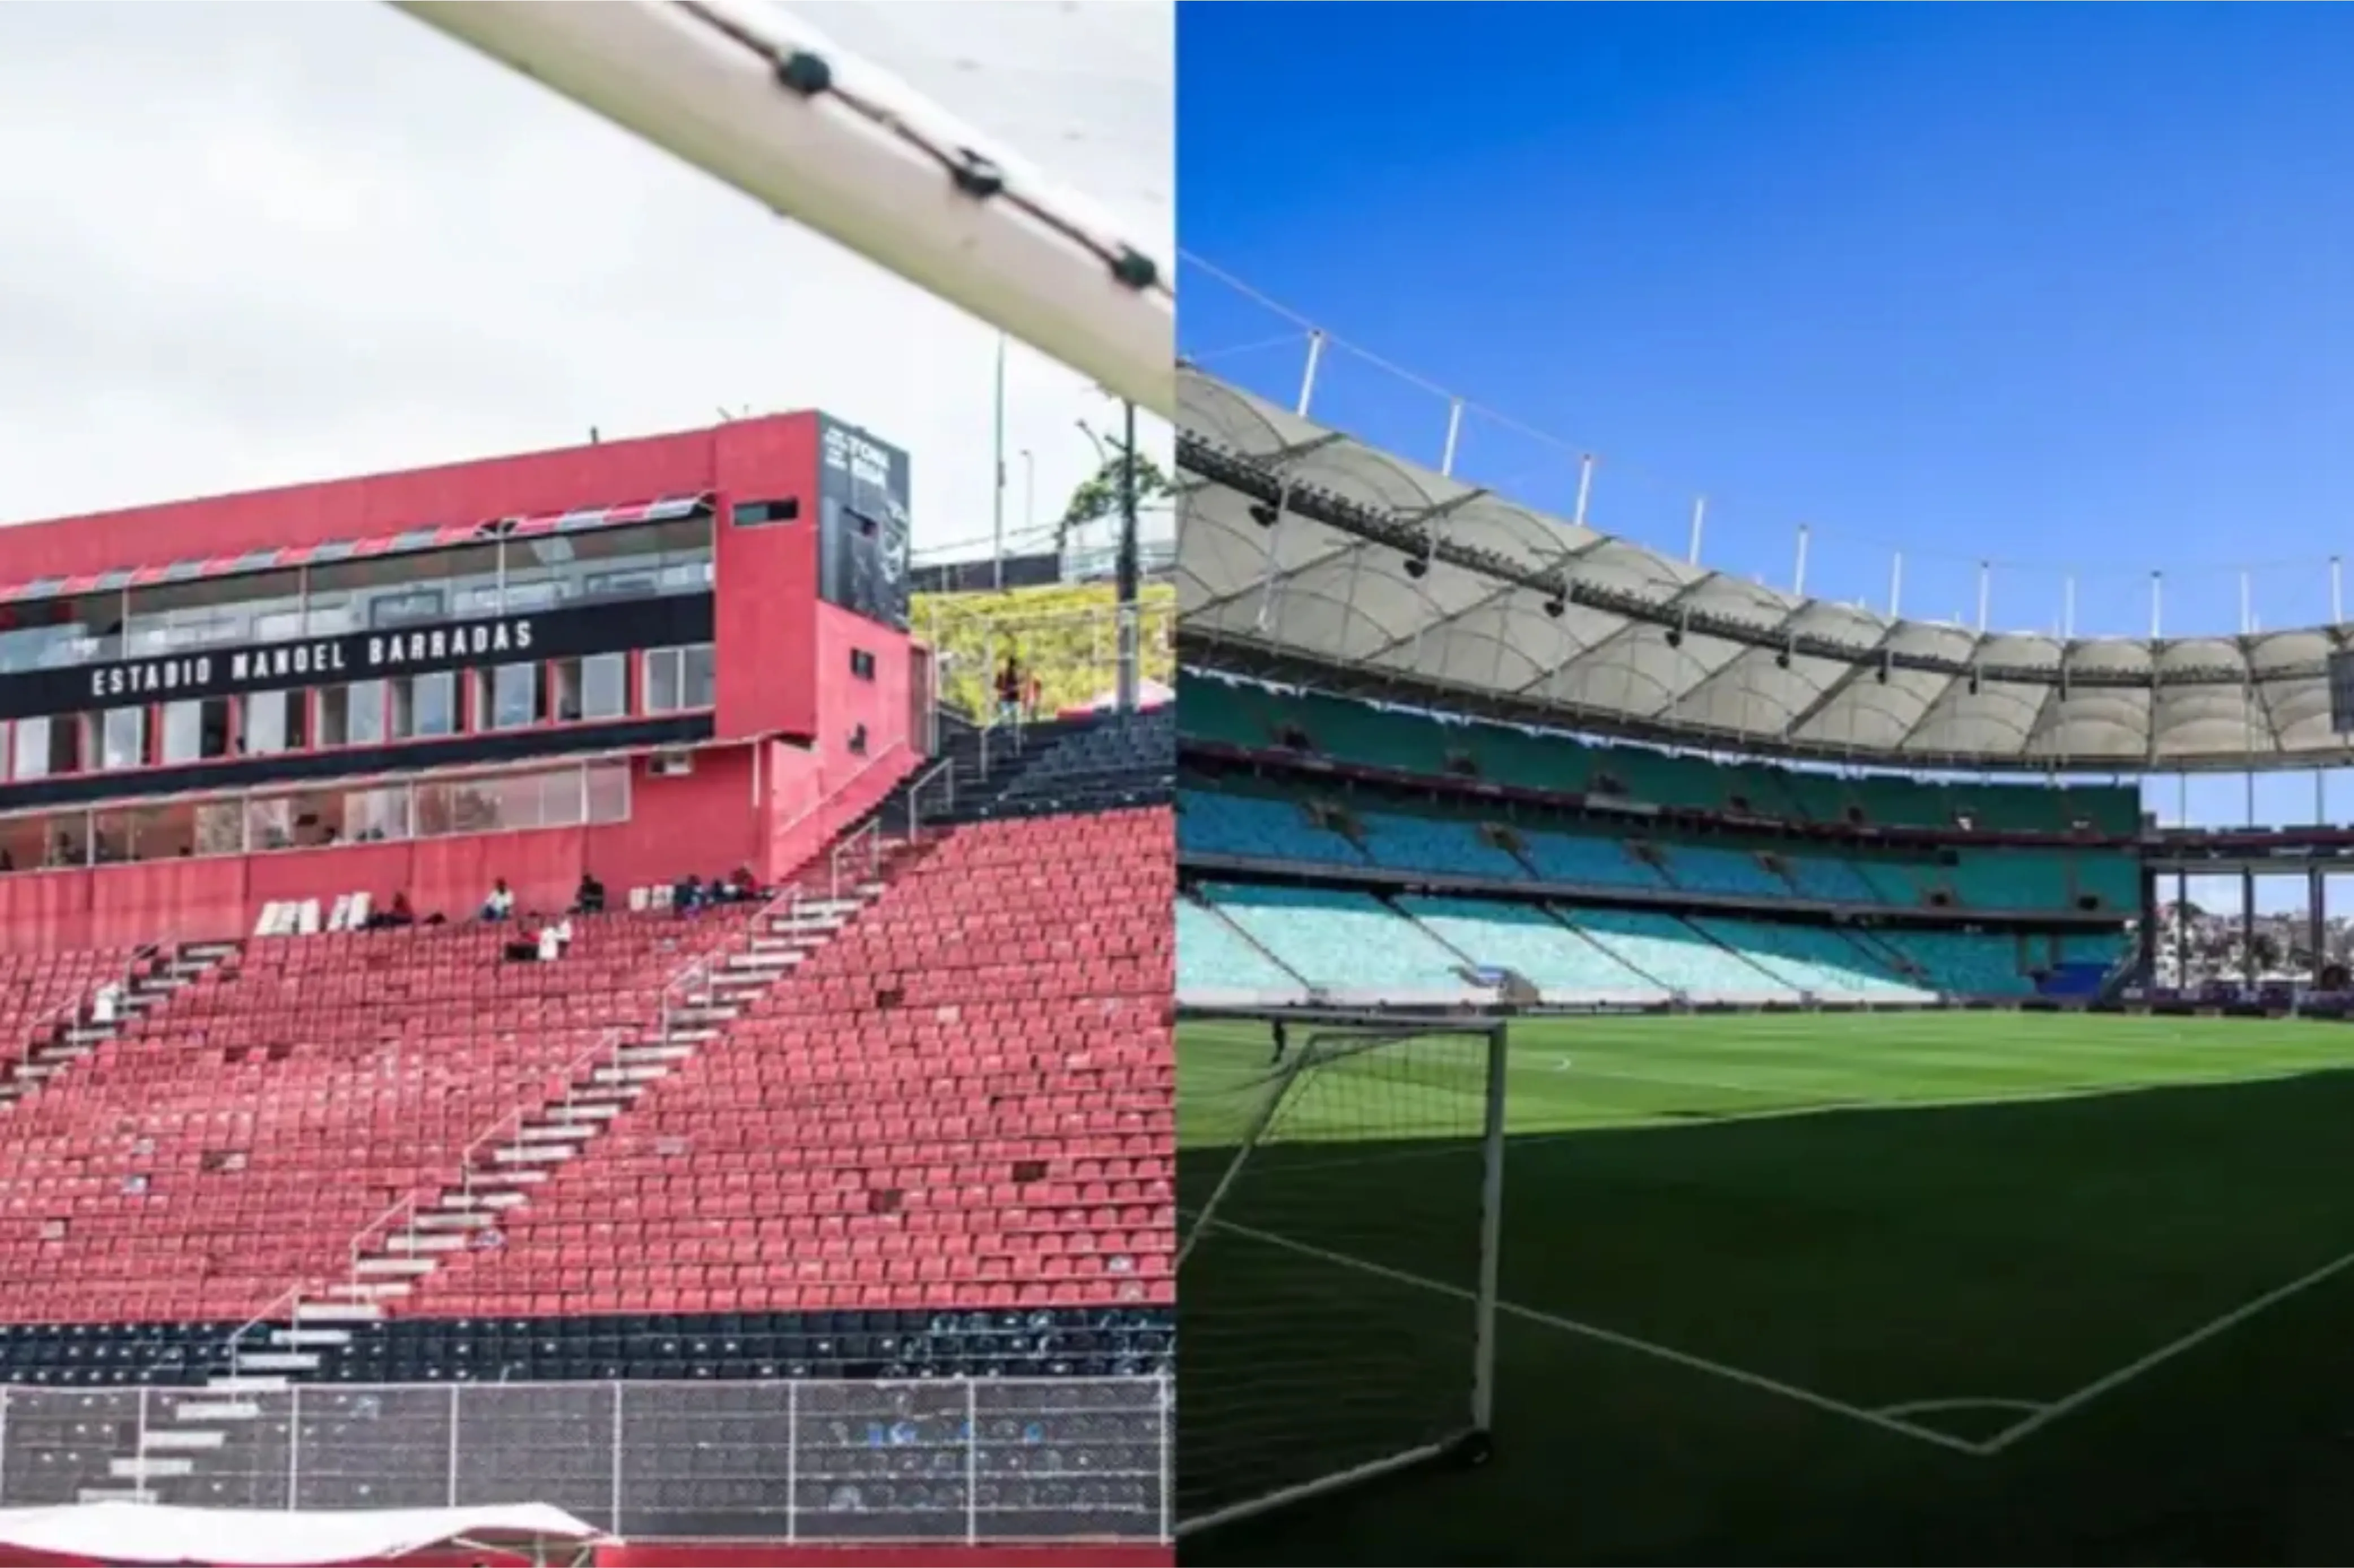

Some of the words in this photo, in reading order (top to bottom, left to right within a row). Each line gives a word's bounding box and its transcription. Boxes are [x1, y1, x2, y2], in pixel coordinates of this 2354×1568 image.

[92, 657, 211, 696] ESTADIO
[232, 642, 345, 680] MANOEL
[369, 620, 531, 664] BARRADAS
